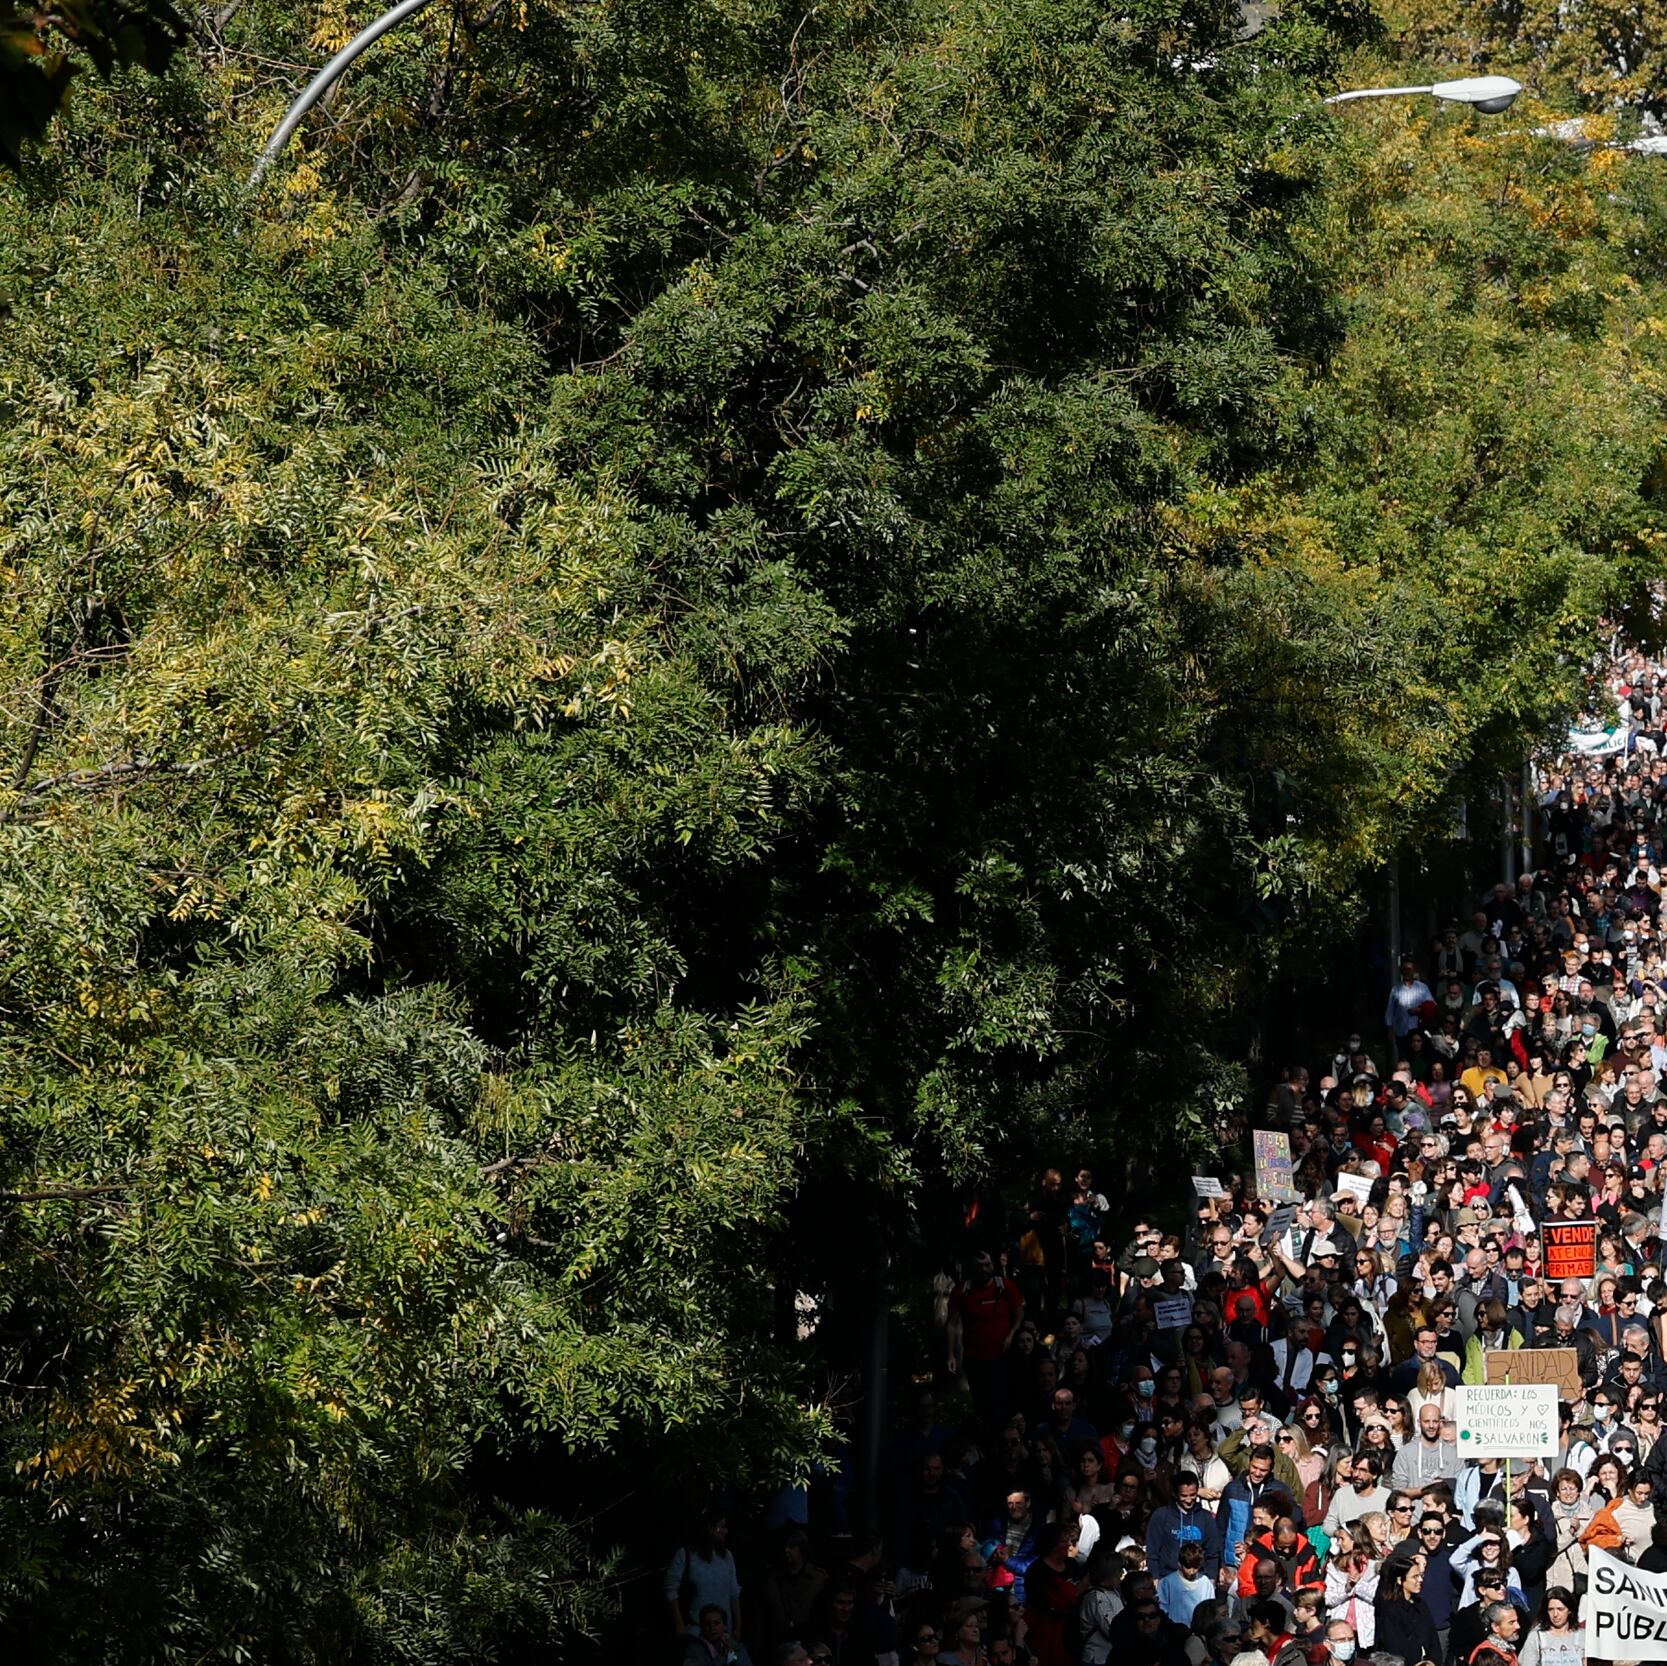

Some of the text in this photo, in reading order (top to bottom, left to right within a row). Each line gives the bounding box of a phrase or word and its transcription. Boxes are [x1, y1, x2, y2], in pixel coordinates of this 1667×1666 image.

[1487, 1349, 1575, 1378] SANIDAD
[1467, 1389, 1538, 1401] RECUERDA: LOS
[1467, 1403, 1529, 1417] MÉDICOS Y
[1529, 1420, 1548, 1430] NOS
[1483, 1433, 1540, 1446] SALVARON
